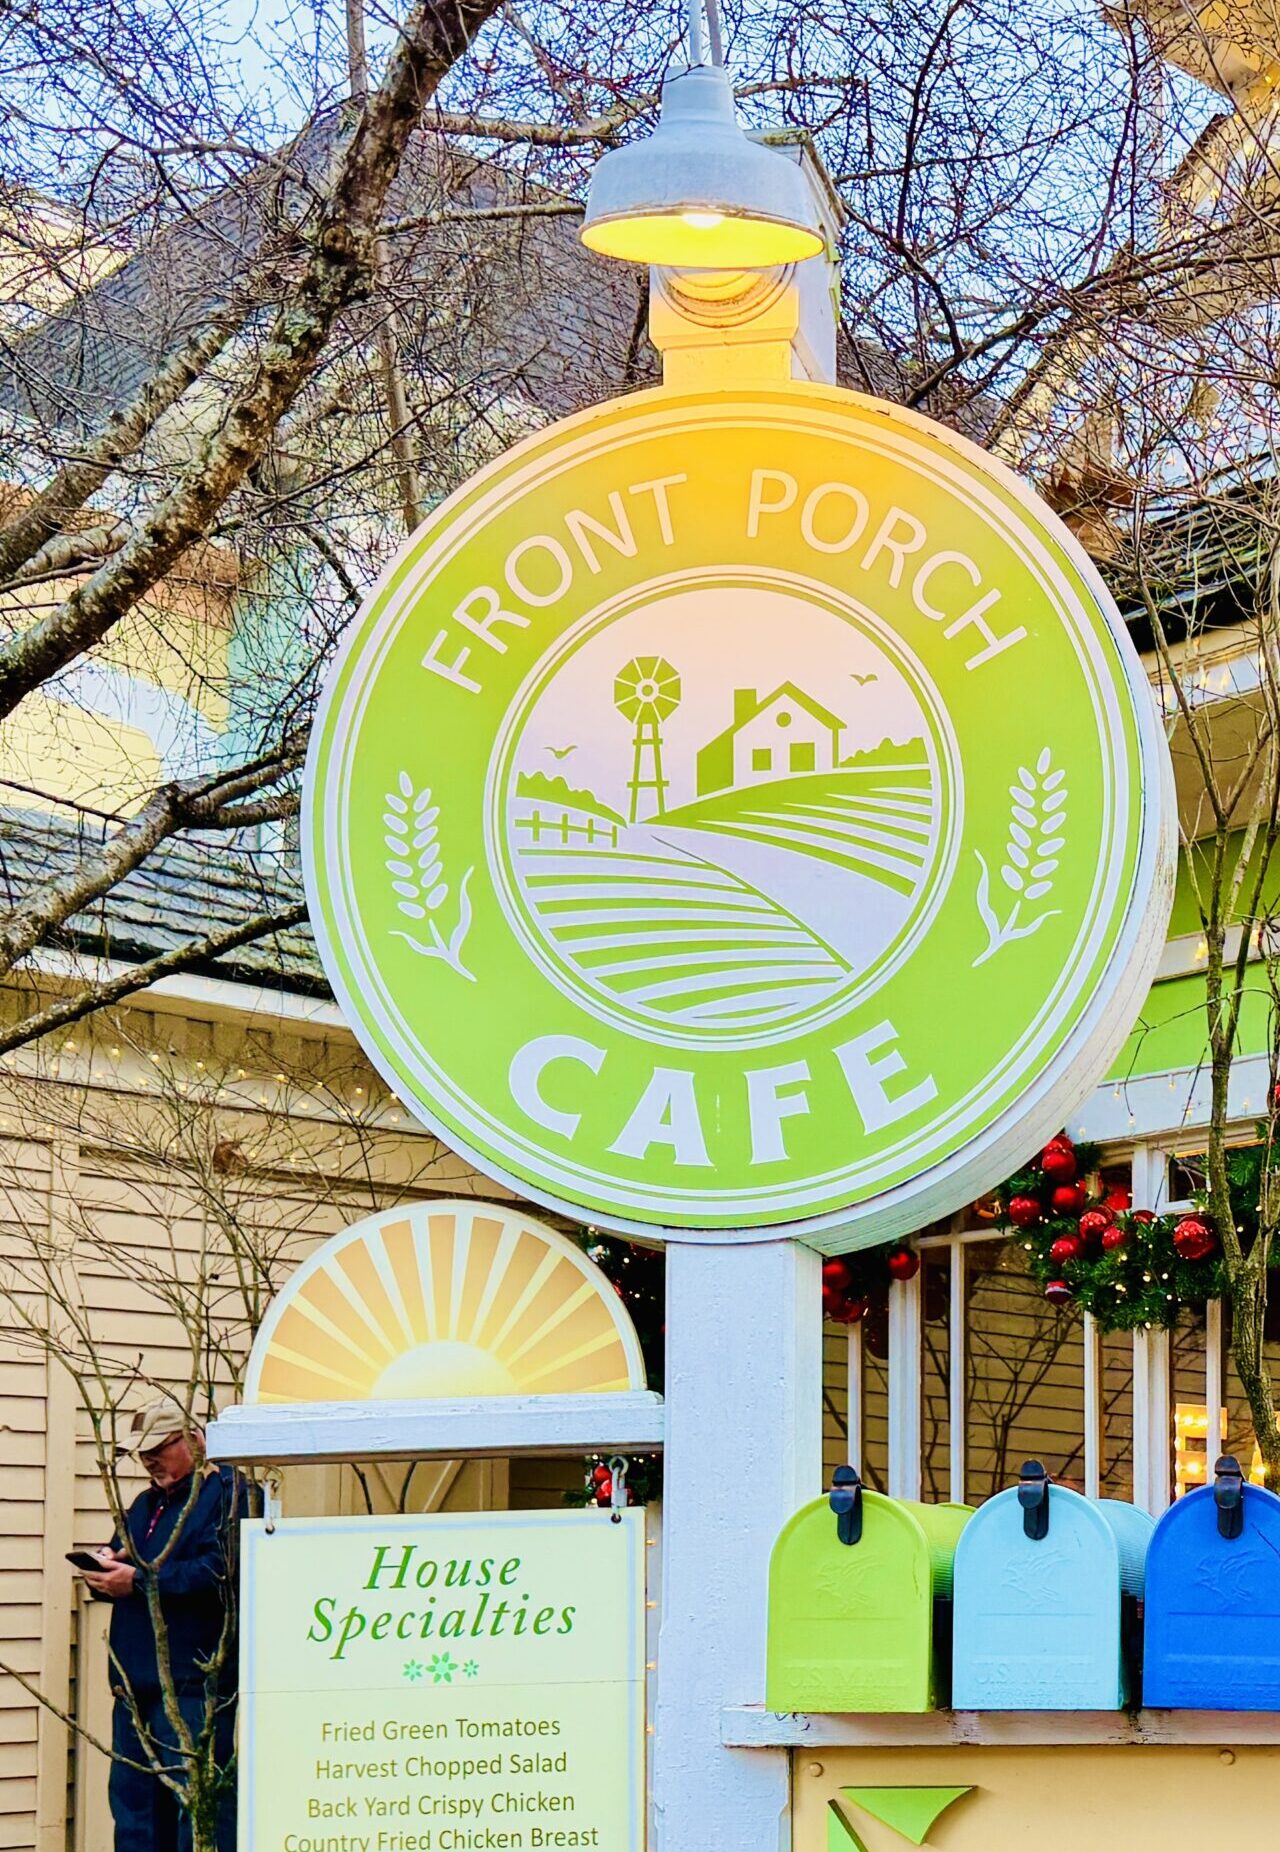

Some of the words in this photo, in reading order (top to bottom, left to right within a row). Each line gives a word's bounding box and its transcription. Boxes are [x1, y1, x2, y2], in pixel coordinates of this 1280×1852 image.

[420, 472, 688, 696] FRONT
[746, 468, 1029, 672] PORCH
[508, 1019, 939, 1169] CAFE
[362, 1545, 522, 1590] House
[307, 1593, 578, 1660] Specialties
[322, 1720, 376, 1742] Fried
[382, 1720, 449, 1742] Green
[456, 1718, 562, 1739] Tomatoes
[316, 1758, 398, 1780] Harvest
[405, 1753, 503, 1781] Chopped
[509, 1752, 568, 1775] Salad
[308, 1797, 358, 1819] Back
[364, 1795, 411, 1817] Yard
[418, 1794, 485, 1819] Crispy
[491, 1791, 576, 1814] Chicken
[284, 1833, 371, 1852] Country
[378, 1829, 432, 1852] Fried
[439, 1828, 524, 1851] Chicken
[531, 1827, 600, 1848] Breast
